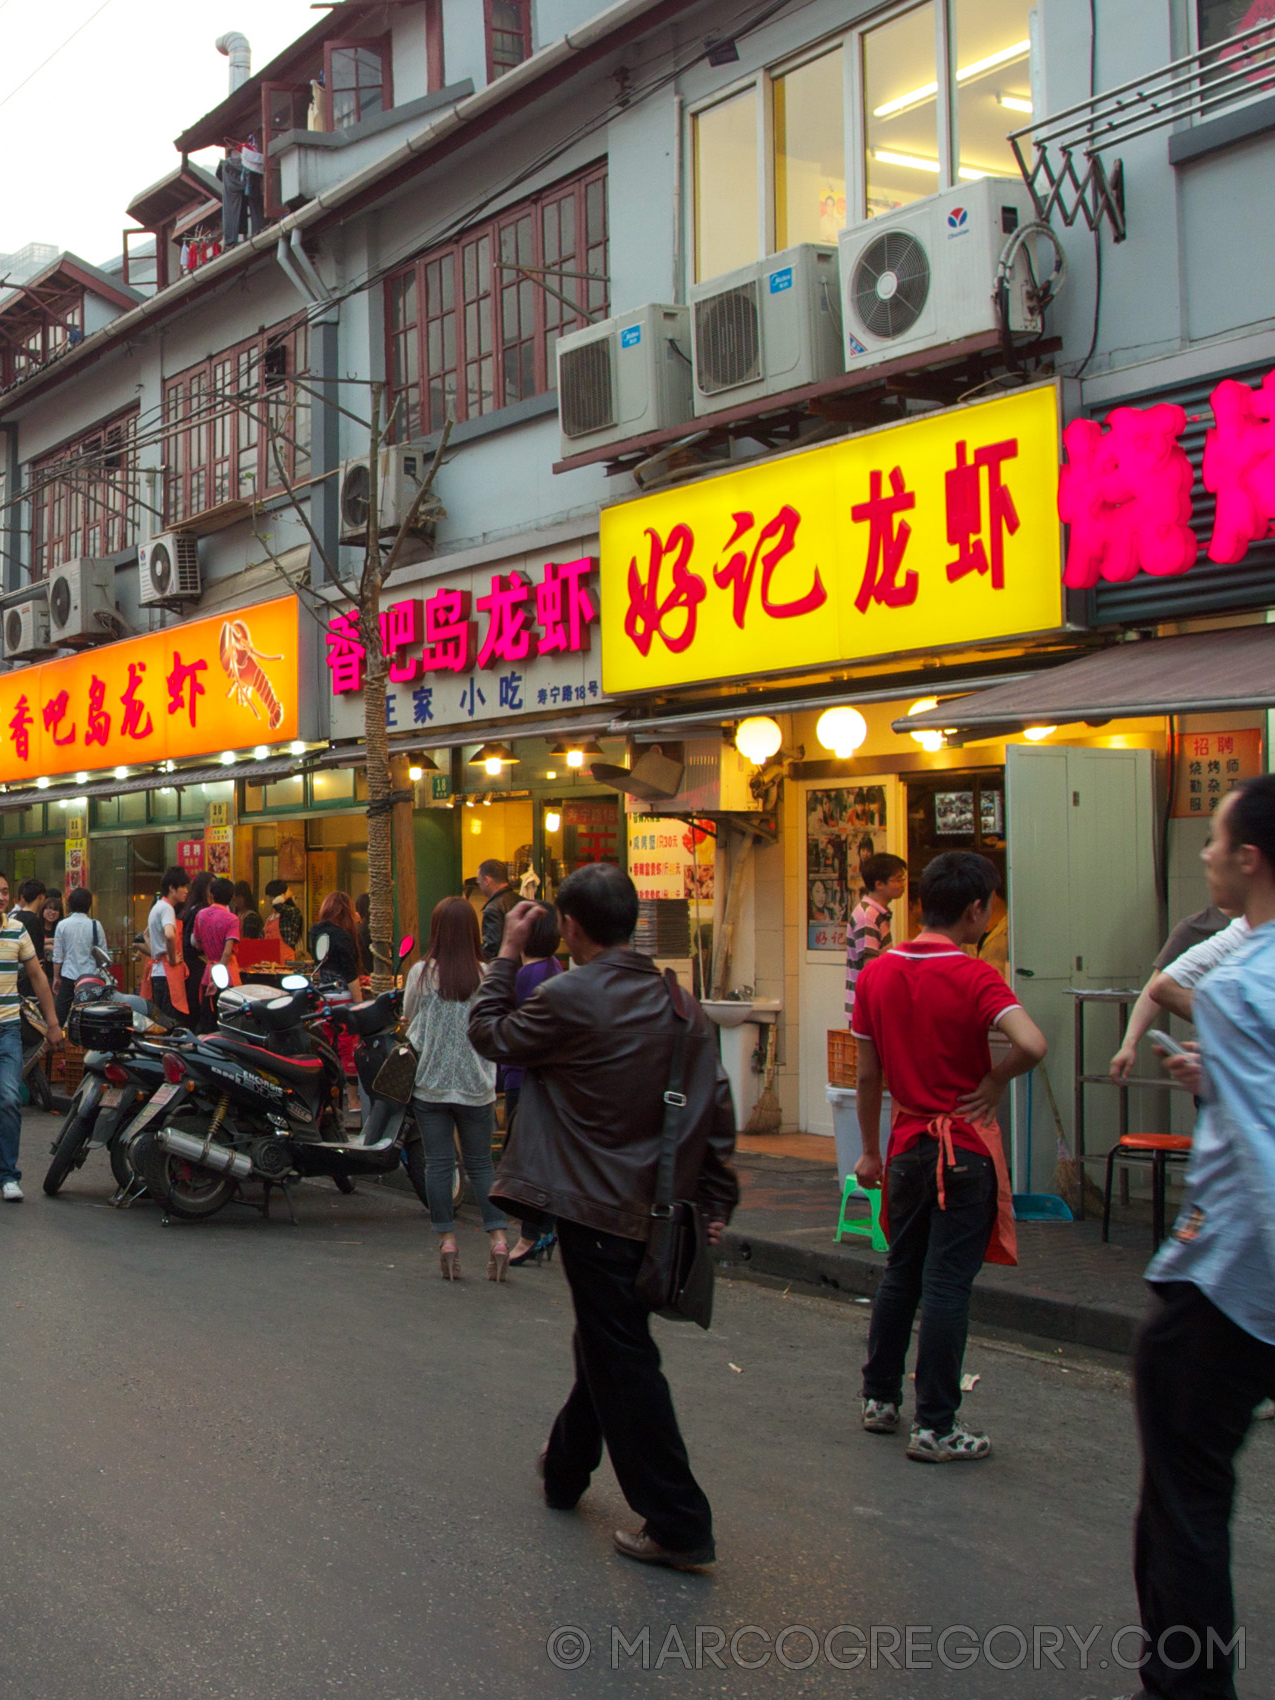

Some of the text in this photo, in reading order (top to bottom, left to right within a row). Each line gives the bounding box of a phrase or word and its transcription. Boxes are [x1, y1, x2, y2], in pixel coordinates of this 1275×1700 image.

[625, 438, 1021, 658] 好记龙虾
[537, 681, 599, 704] 寿宁路18号
[1194, 736, 1234, 757] 招聘
